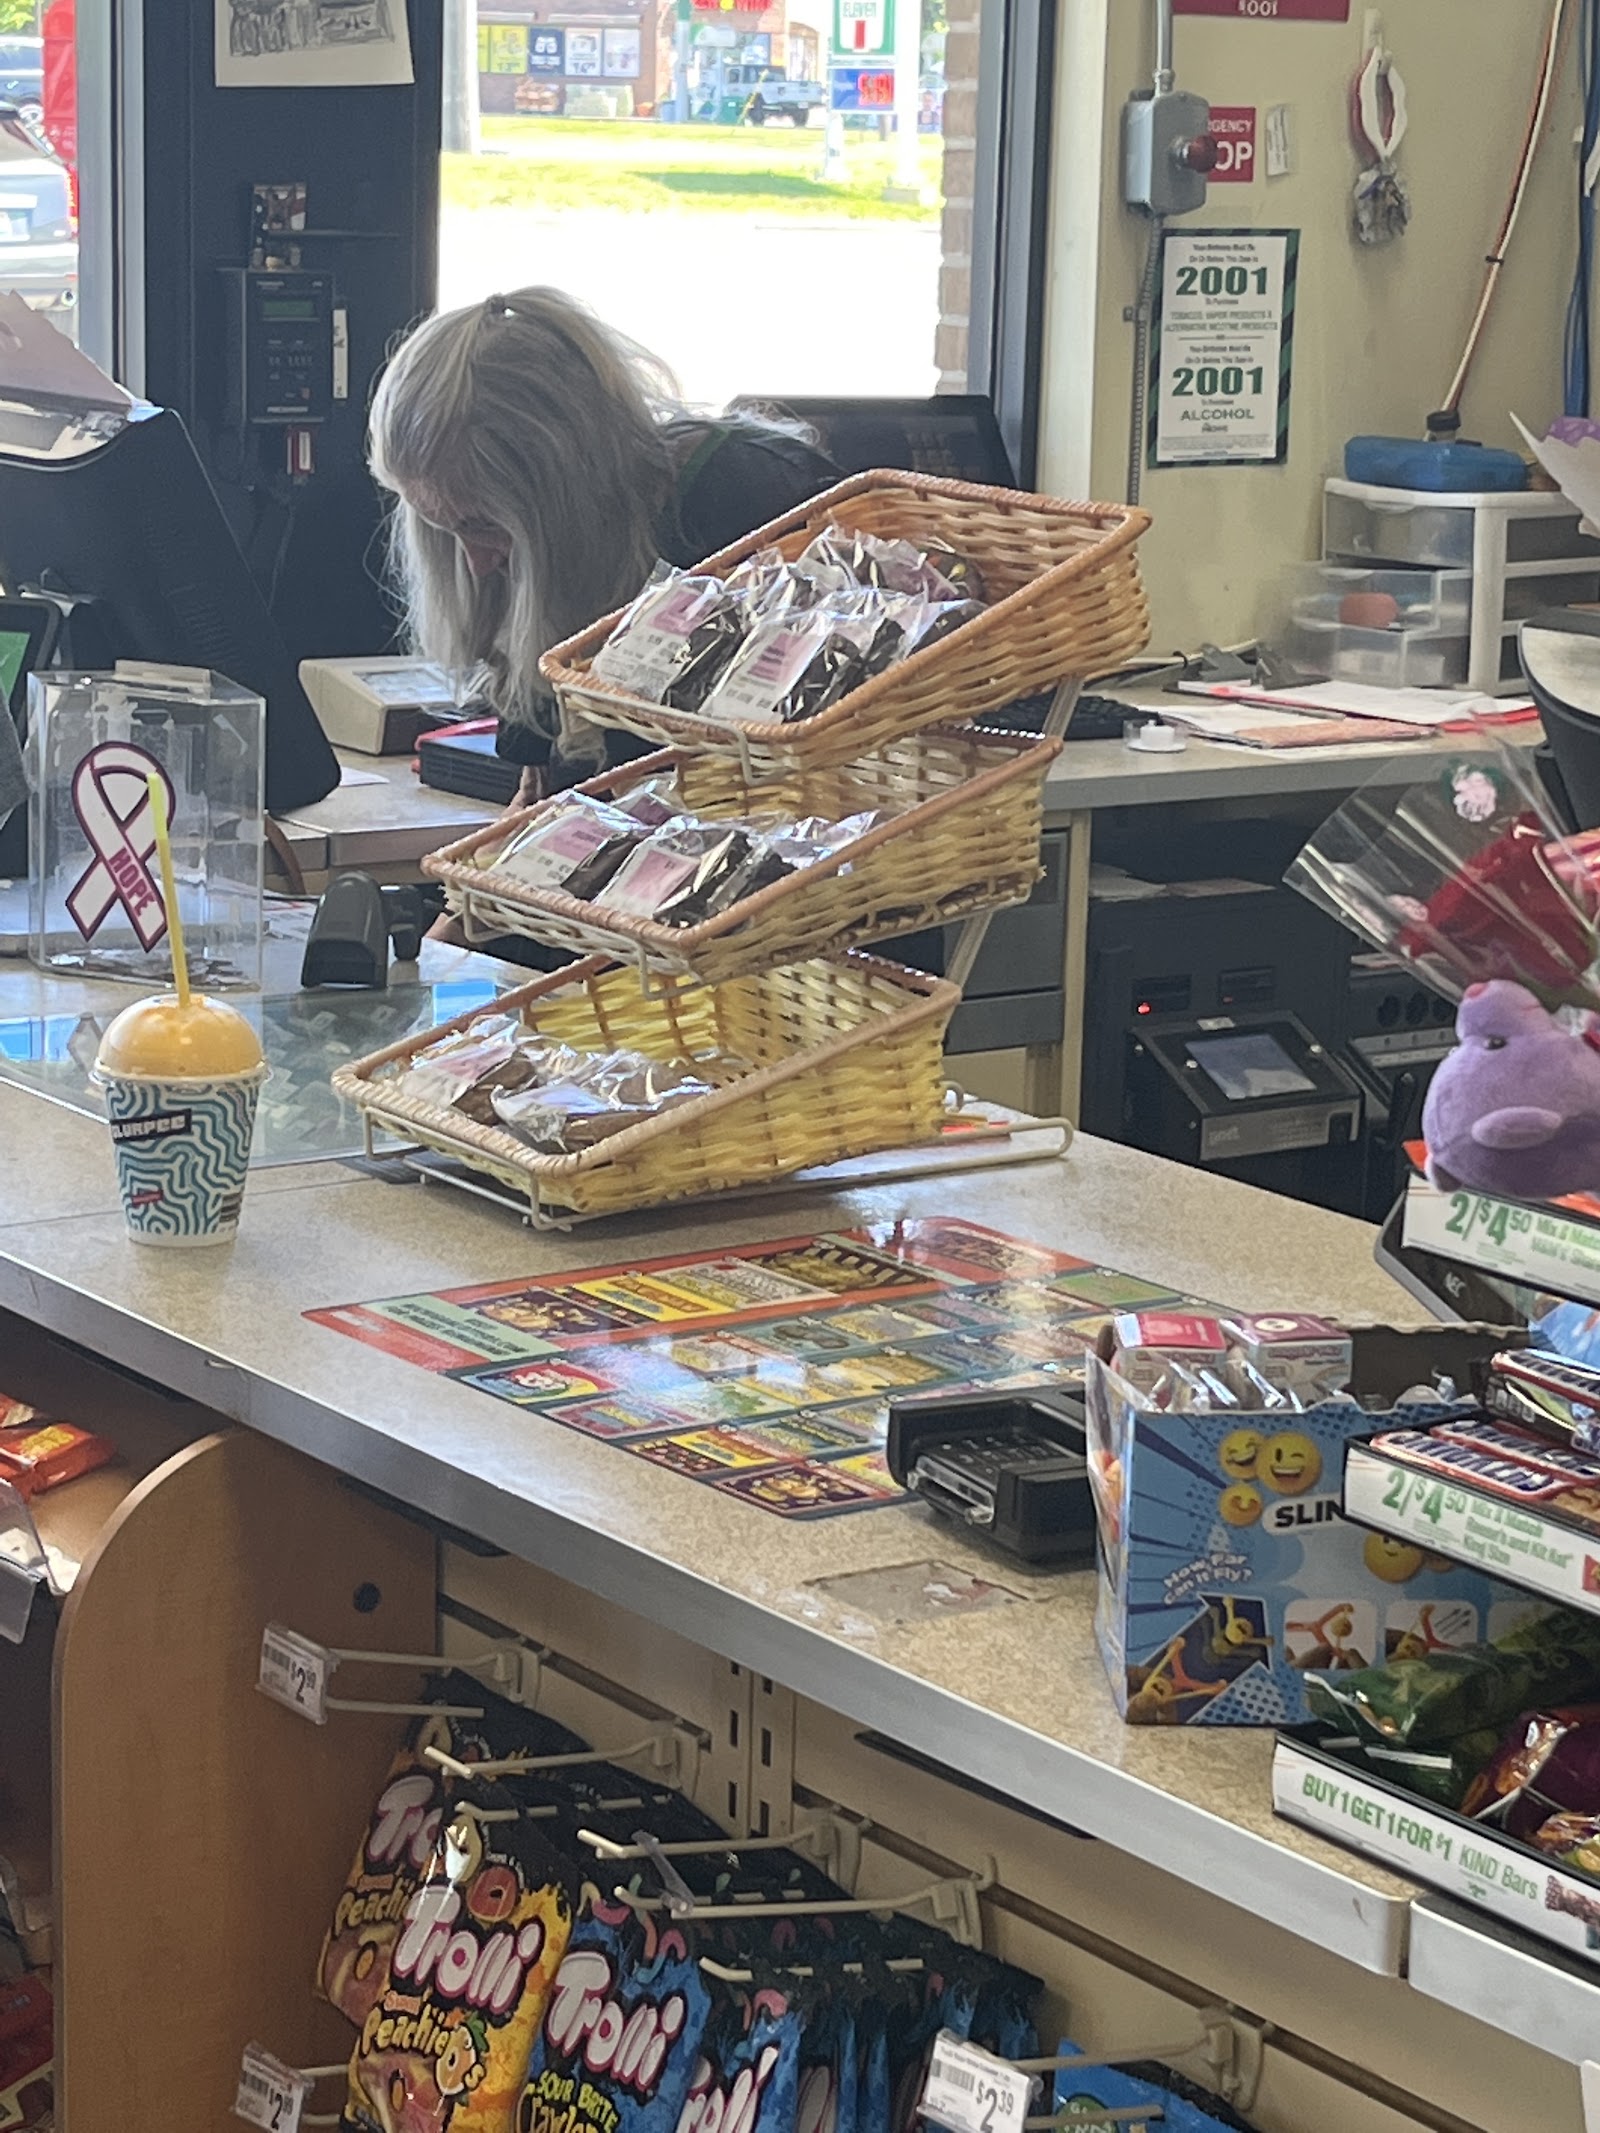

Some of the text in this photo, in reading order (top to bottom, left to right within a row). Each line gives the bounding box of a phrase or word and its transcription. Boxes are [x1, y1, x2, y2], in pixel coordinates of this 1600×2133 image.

[1208, 119, 1252, 133] GENCY
[1215, 141, 1253, 170] OP
[1176, 266, 1267, 295] 2001
[1172, 366, 1263, 396] 2001
[1180, 408, 1255, 421] ALCOHOL
[108, 846, 156, 917] HOPE
[1443, 1272, 1467, 1298] NEC
[1274, 1500, 1345, 1527] SLIN
[1164, 1553, 1247, 1588] How Far
[1213, 1566, 1253, 1583] Fly?
[367, 1776, 443, 1869] Tro
[1302, 1773, 1340, 1807] BUY
[1341, 1791, 1350, 1814] 1
[1350, 1795, 1386, 1829] GET
[1387, 1812, 1396, 1836] 1
[1396, 1817, 1435, 1852] FOR
[1436, 1832, 1454, 1861] $1
[1458, 1844, 1500, 1880] KIND
[1500, 1865, 1539, 1901] Bars
[393, 1884, 543, 2014] Trolli
[548, 1951, 685, 2091] Trolli
[537, 2069, 619, 2133] SOUR BRITE
